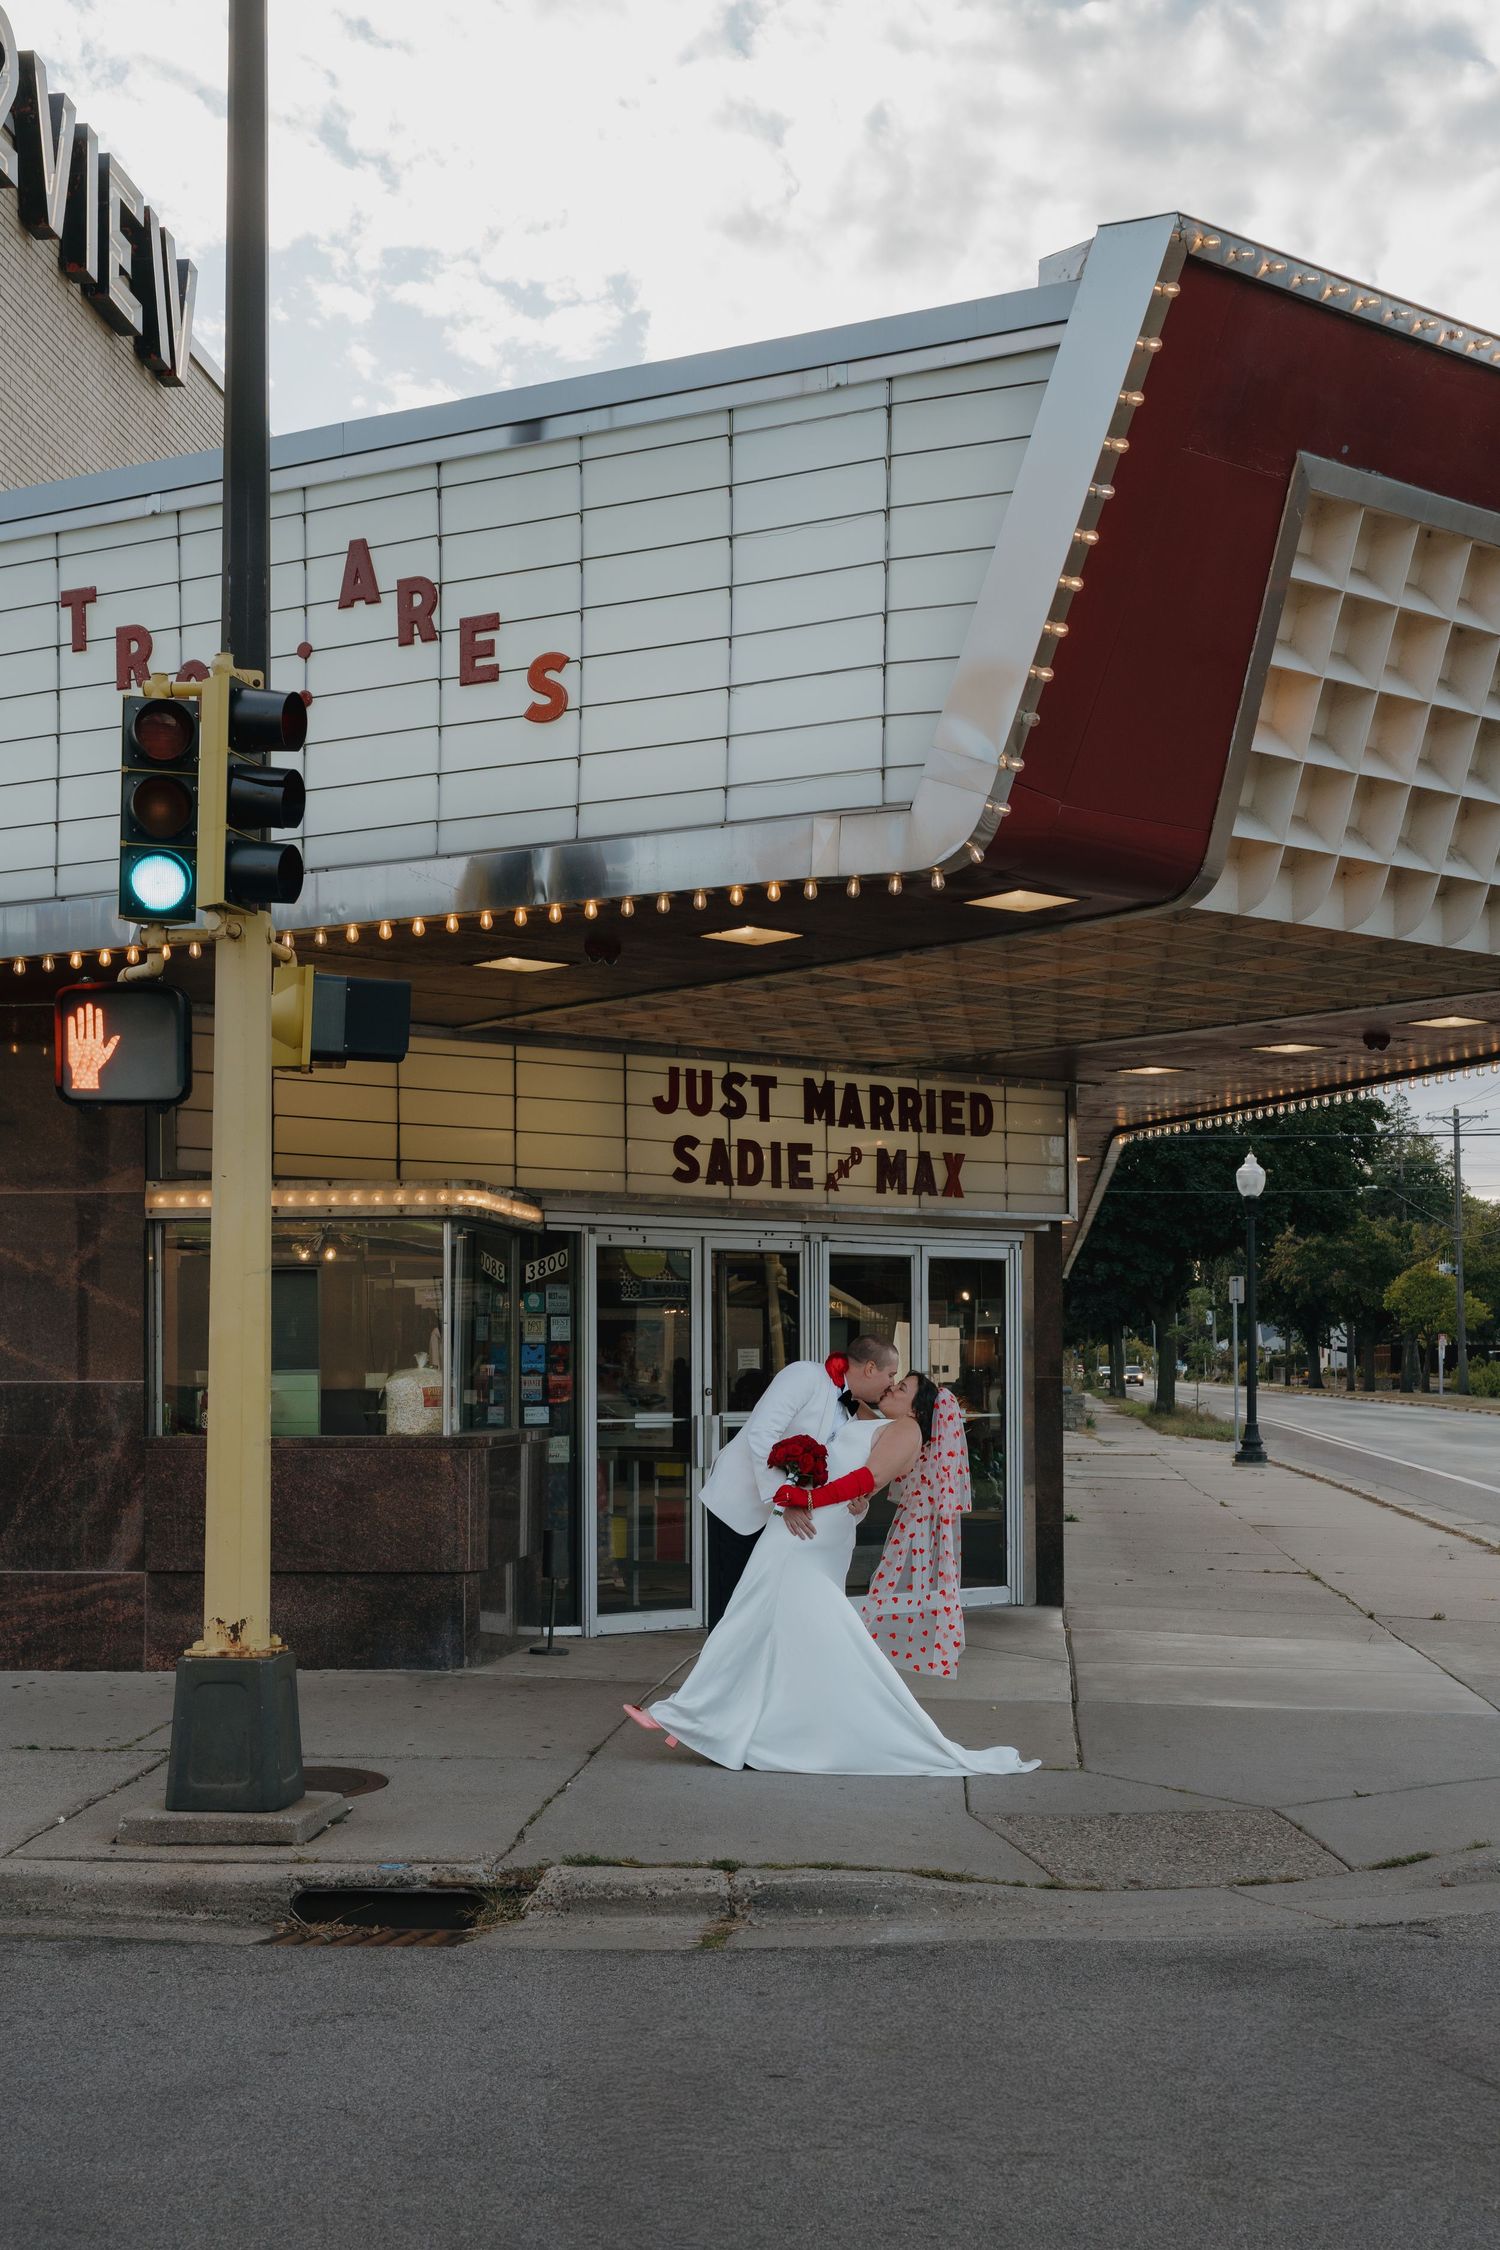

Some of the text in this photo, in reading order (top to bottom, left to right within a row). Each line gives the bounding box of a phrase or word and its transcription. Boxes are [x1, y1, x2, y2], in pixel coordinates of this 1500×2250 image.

[337, 537, 571, 723] ARES
[652, 1066, 995, 1137] JUST MARRIED
[672, 1134, 966, 1199] SADIE AND MAX
[527, 1252, 567, 1280] 3800
